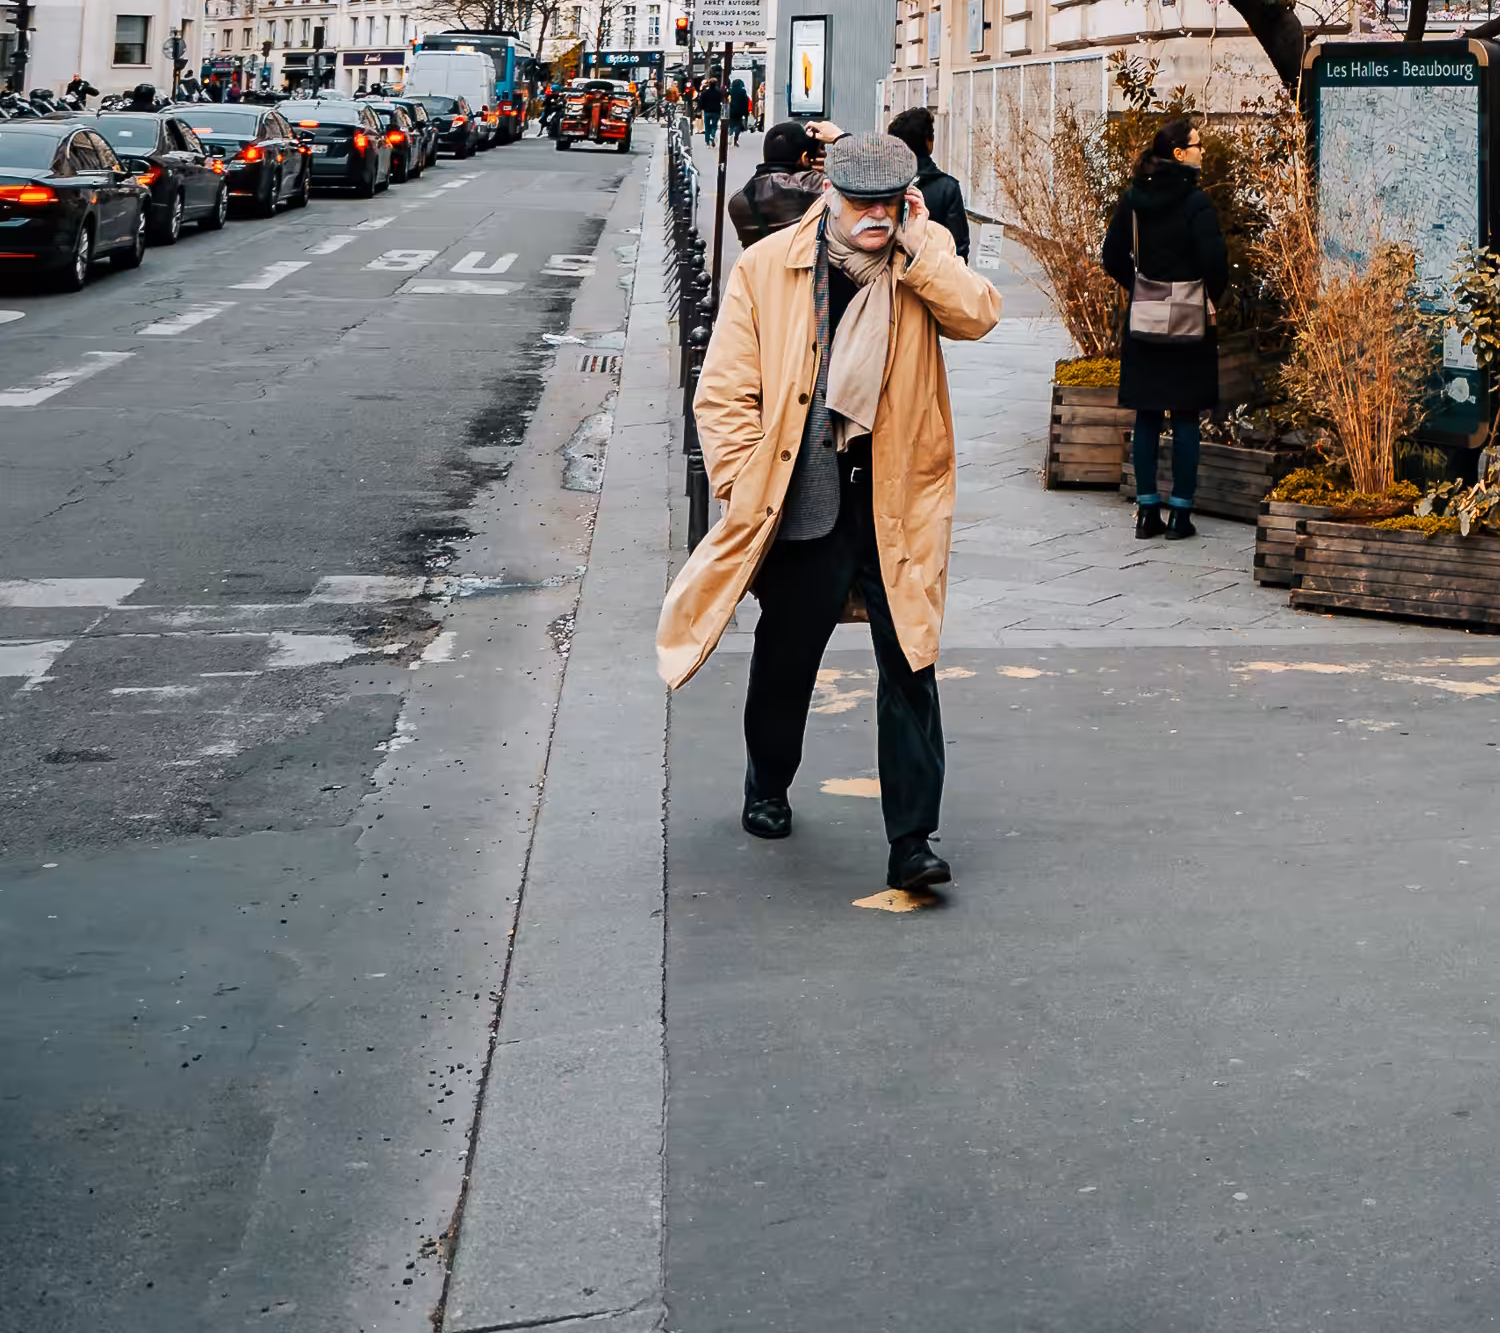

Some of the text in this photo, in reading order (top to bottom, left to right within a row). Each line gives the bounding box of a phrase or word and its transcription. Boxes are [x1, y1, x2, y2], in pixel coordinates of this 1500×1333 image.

[1326, 61, 1348, 78] Les
[1351, 60, 1389, 78] Halles
[1402, 60, 1474, 81] Beaubourg
[360, 249, 599, 277] BUS
